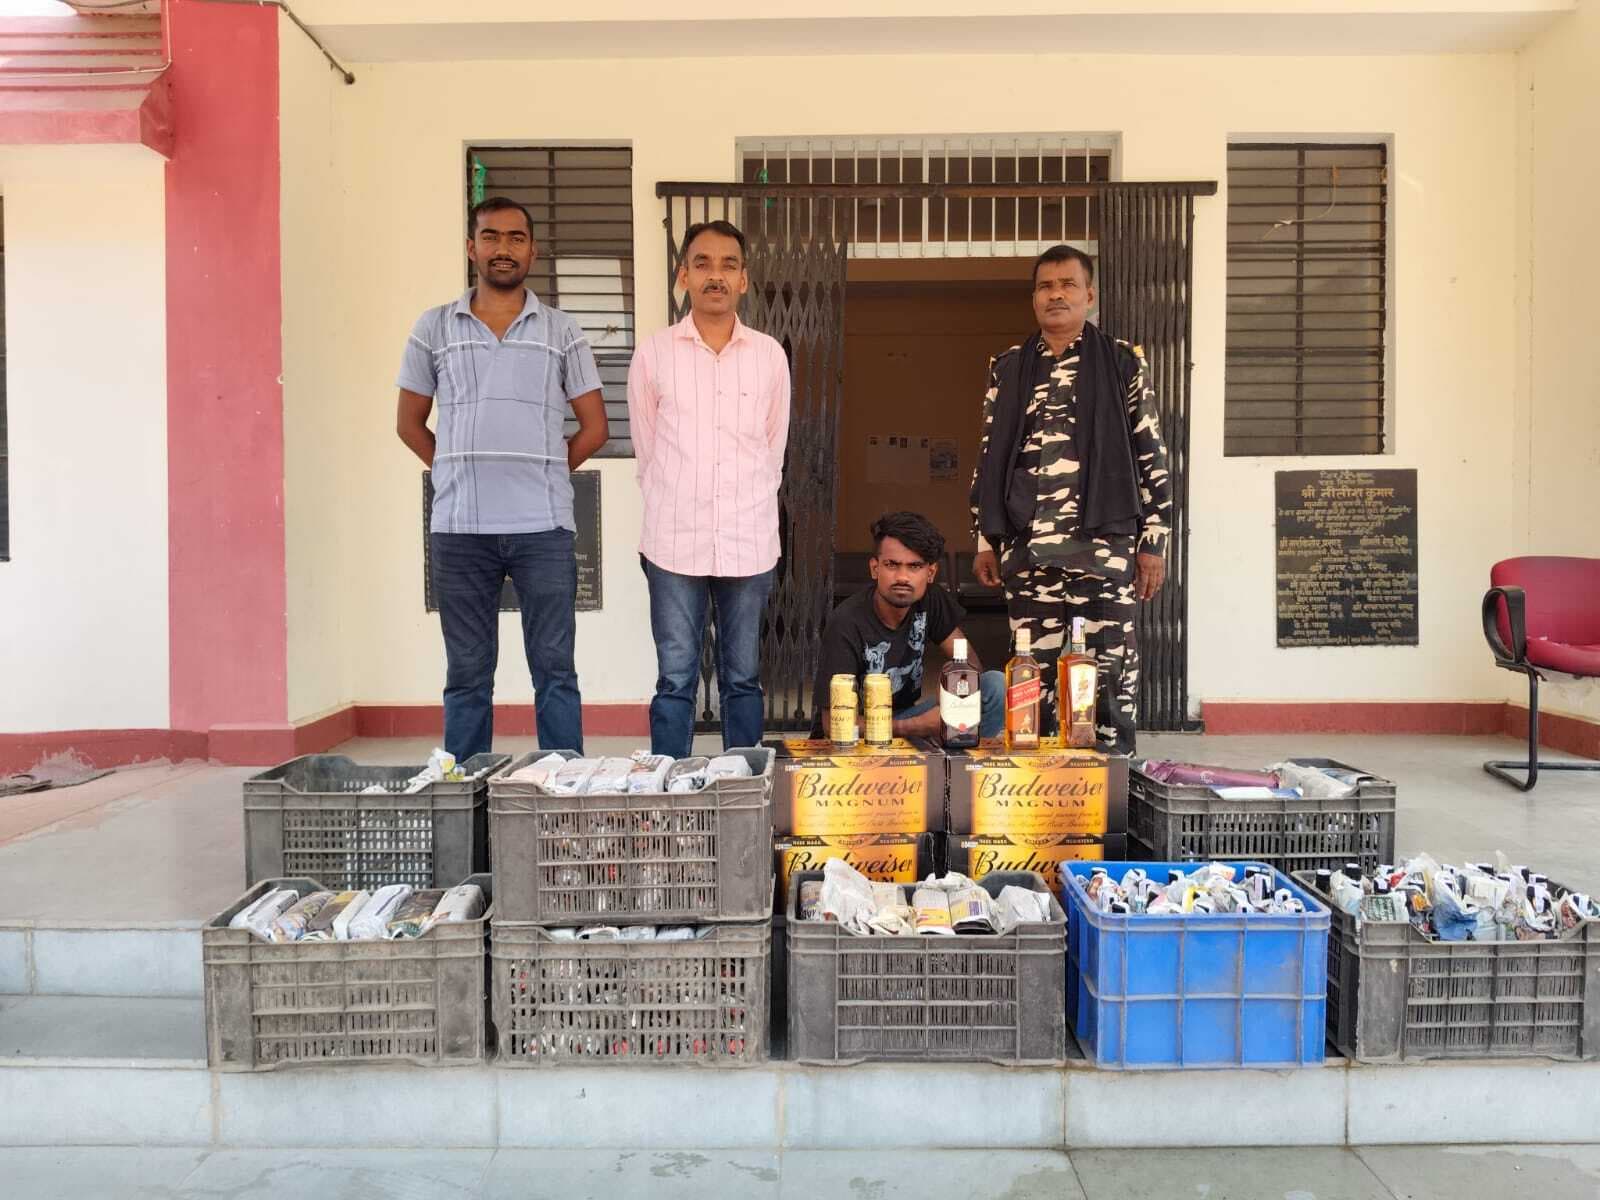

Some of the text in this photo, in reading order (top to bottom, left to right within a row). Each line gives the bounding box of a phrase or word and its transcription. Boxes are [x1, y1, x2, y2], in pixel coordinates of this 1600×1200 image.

[796, 772, 922, 799] Budweiser
[977, 772, 1103, 799] Budweiser
[815, 798, 905, 808] MAGNUM
[995, 799, 1085, 808] MAGNUM
